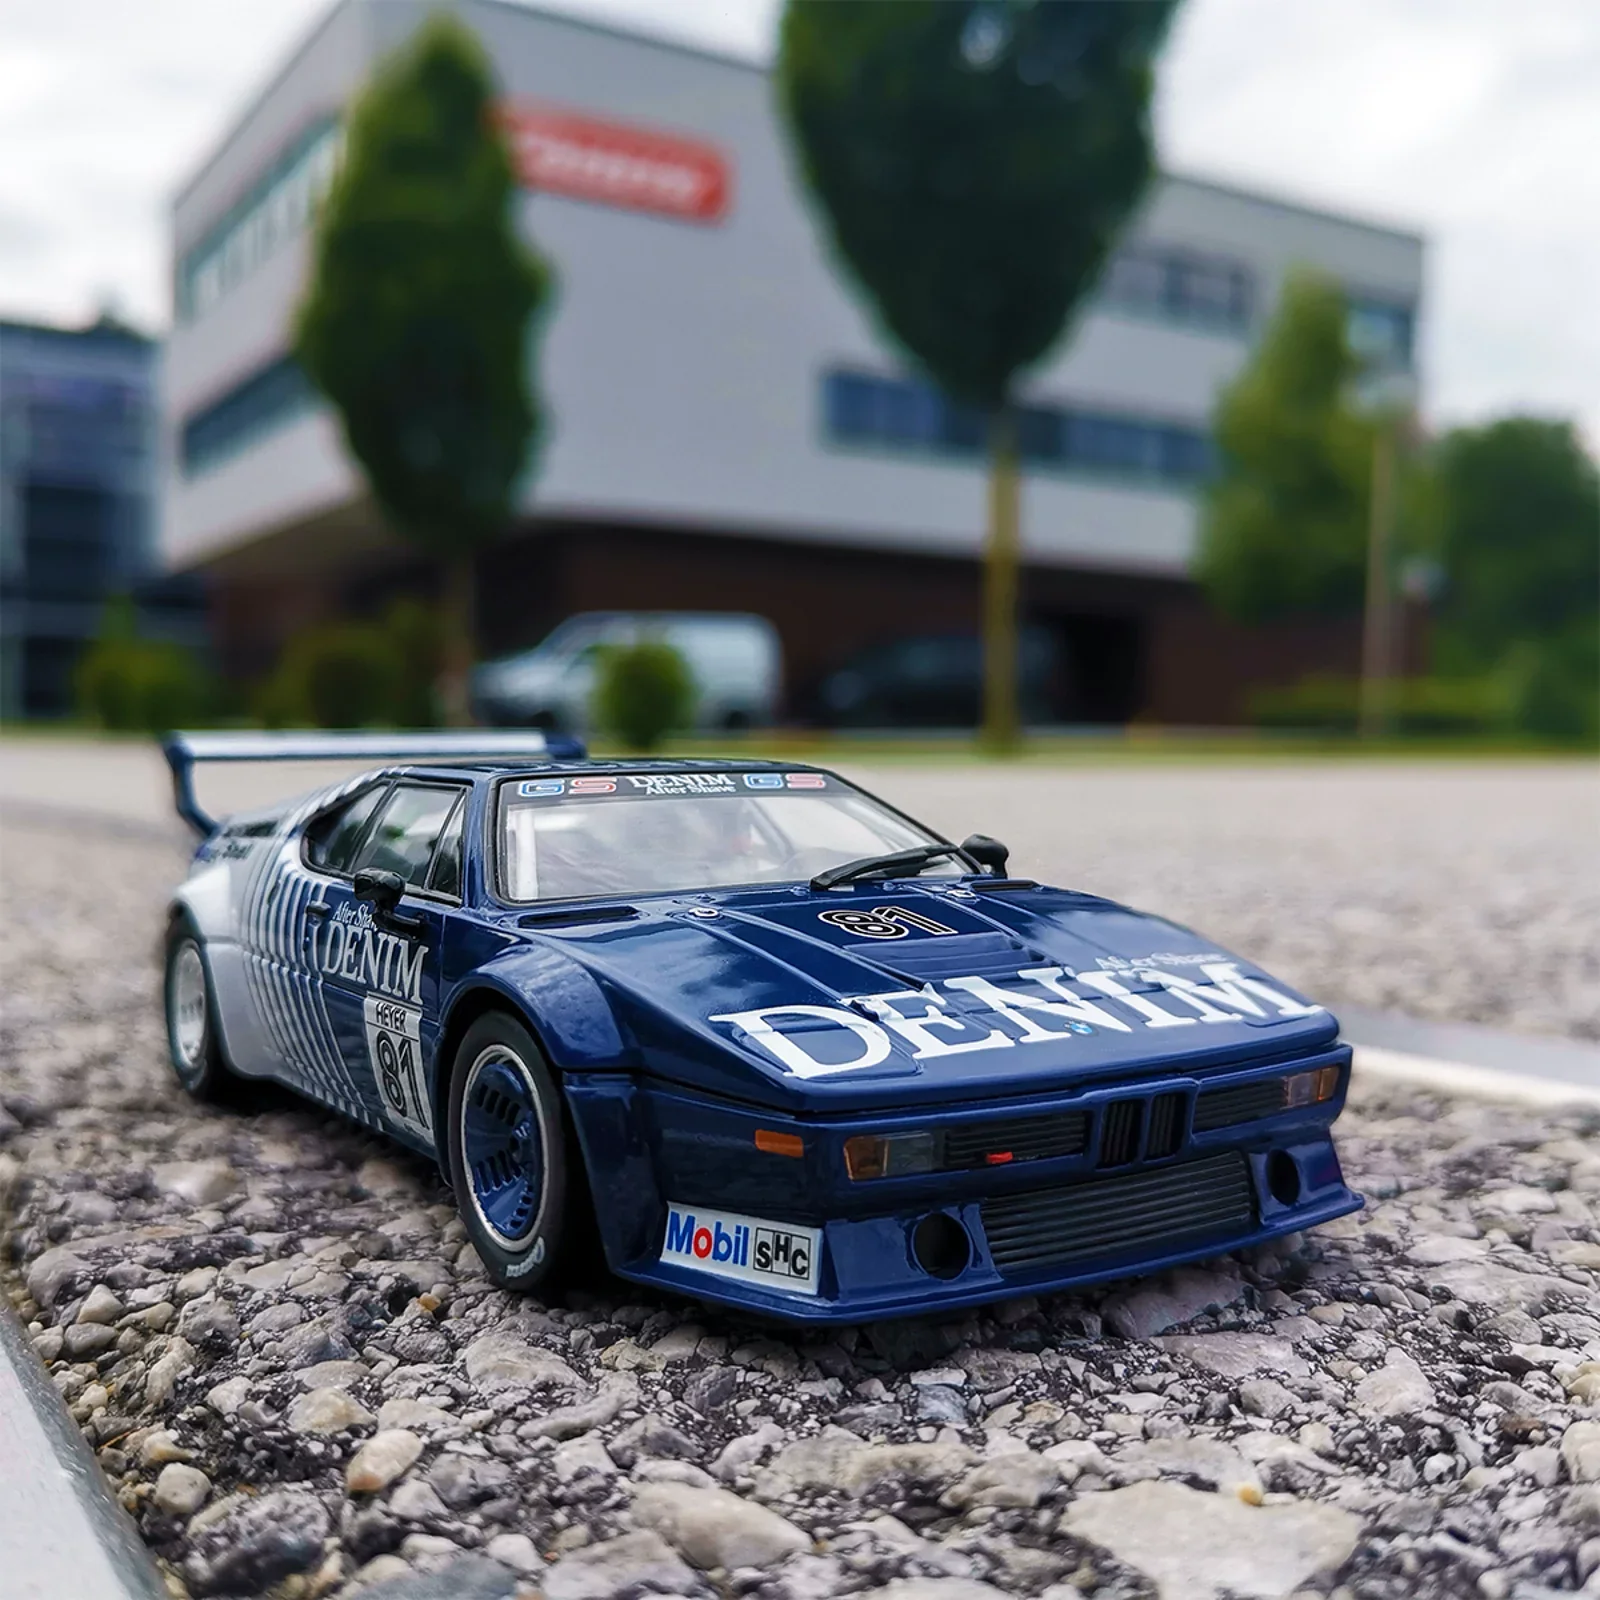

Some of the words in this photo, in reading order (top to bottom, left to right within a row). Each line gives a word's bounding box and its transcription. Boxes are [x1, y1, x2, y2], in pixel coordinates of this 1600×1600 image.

[626, 774, 736, 788] DENIM
[646, 785, 687, 795] After
[689, 784, 736, 794] Shave
[332, 901, 357, 924] After
[818, 906, 959, 940] 81
[321, 920, 429, 1005] DENIM
[376, 1001, 407, 1033] HEYER
[707, 962, 1327, 1078] DENIM
[377, 1030, 429, 1130] 81
[666, 1211, 750, 1267] Mobil
[756, 1234, 808, 1276] SHC
